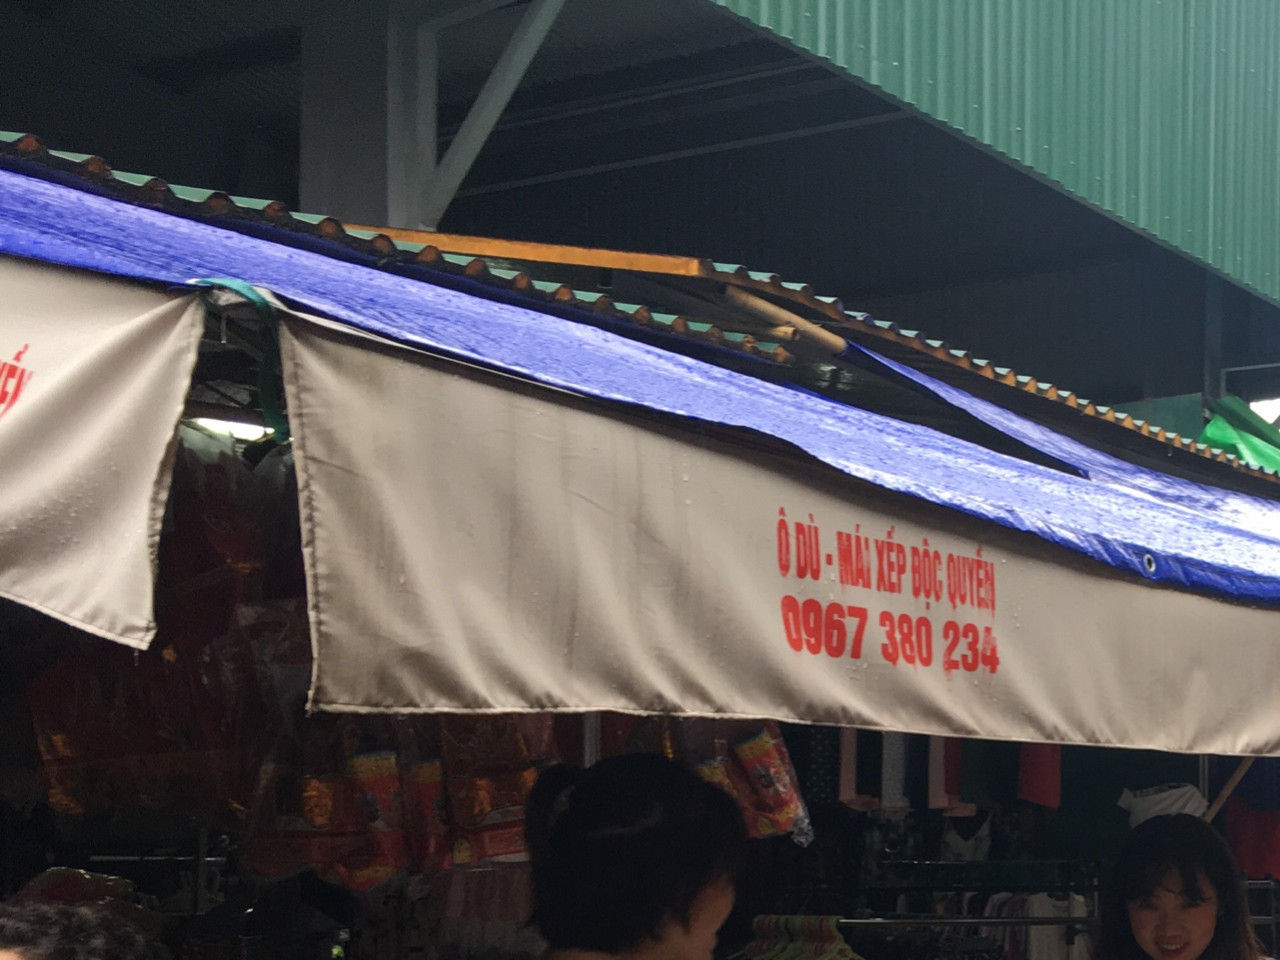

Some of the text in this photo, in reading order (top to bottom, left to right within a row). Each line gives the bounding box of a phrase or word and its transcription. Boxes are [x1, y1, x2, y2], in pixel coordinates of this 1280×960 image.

[777, 507, 791, 578] Ô
[836, 523, 872, 589] MÁI
[874, 526, 908, 594] XẾP
[910, 538, 943, 610] ĐỘC
[780, 594, 1000, 674] 0967 380 234
